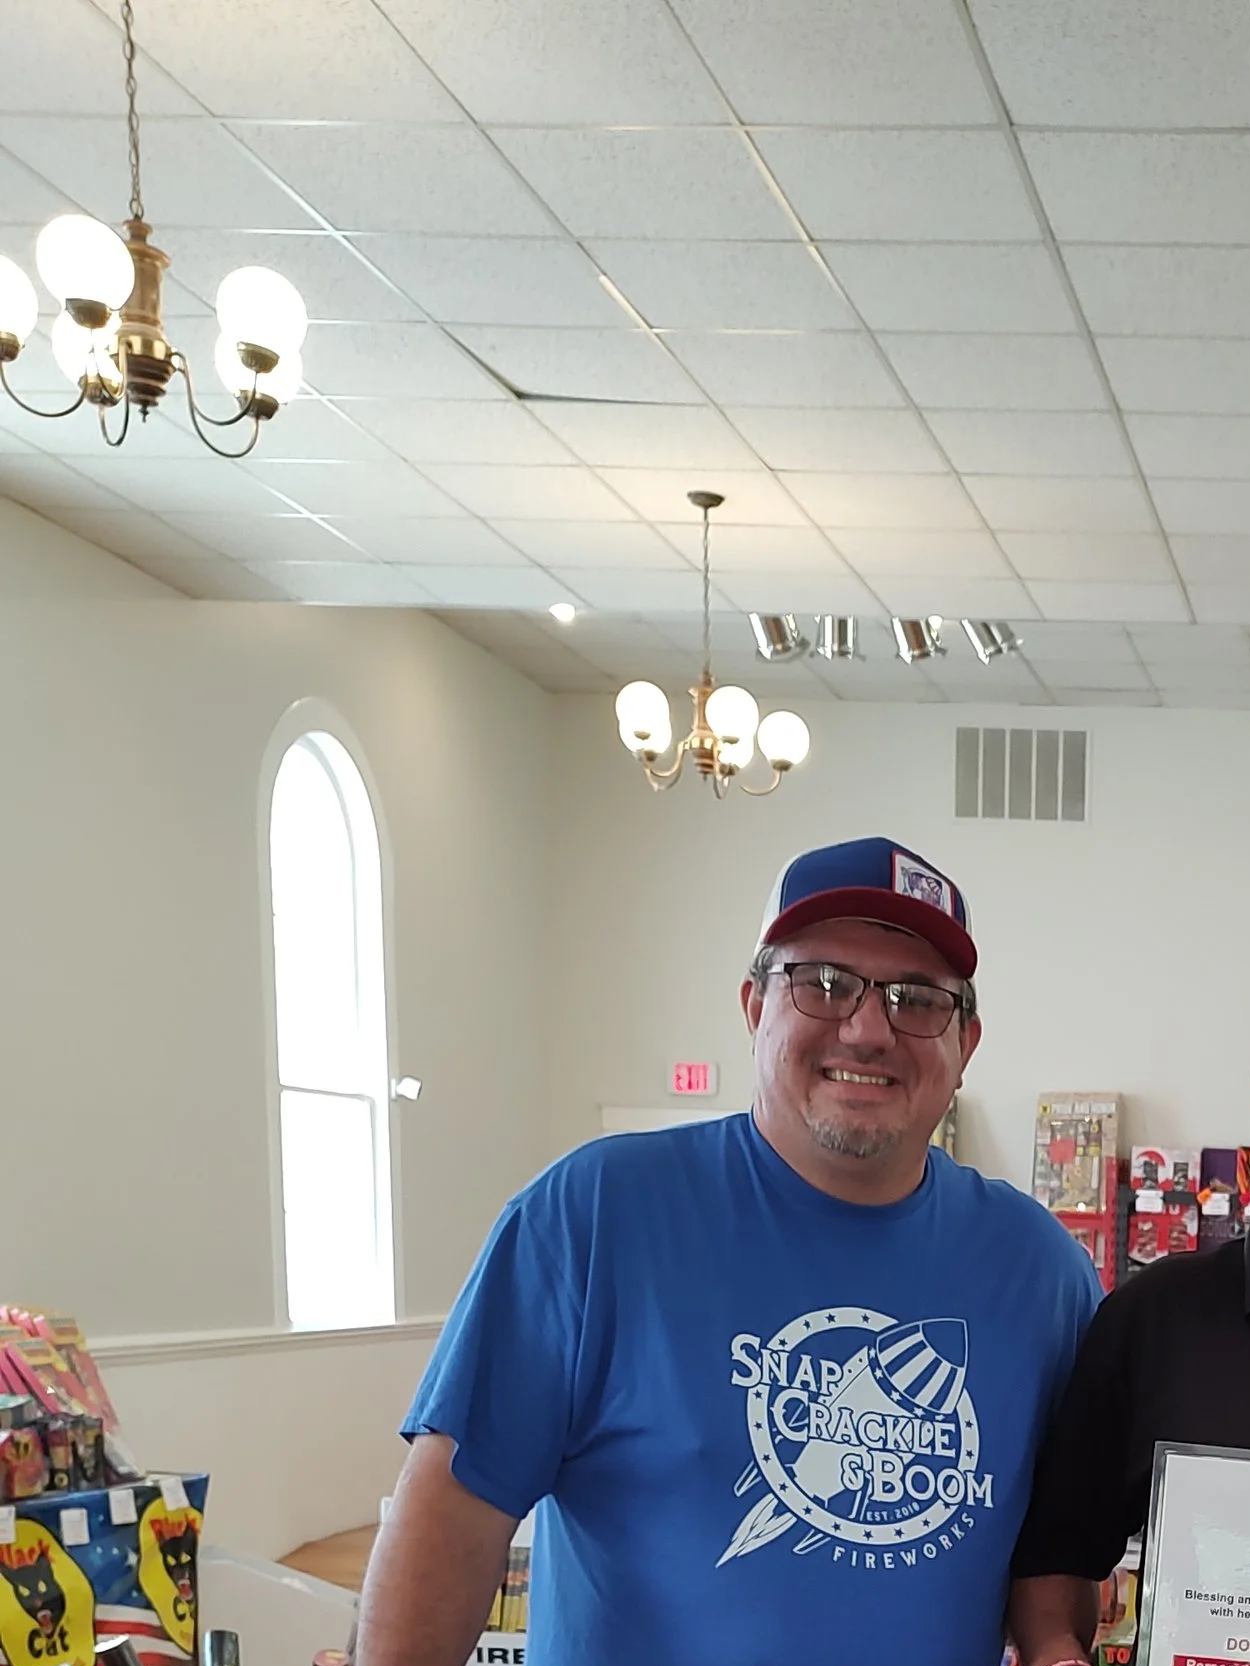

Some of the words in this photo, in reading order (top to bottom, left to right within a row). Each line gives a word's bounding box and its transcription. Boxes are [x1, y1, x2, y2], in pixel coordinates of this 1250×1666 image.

[831, 1512, 976, 1570] FIREWORKS
[1185, 1589, 1234, 1605] Blessing
[1210, 1606, 1234, 1617] with
